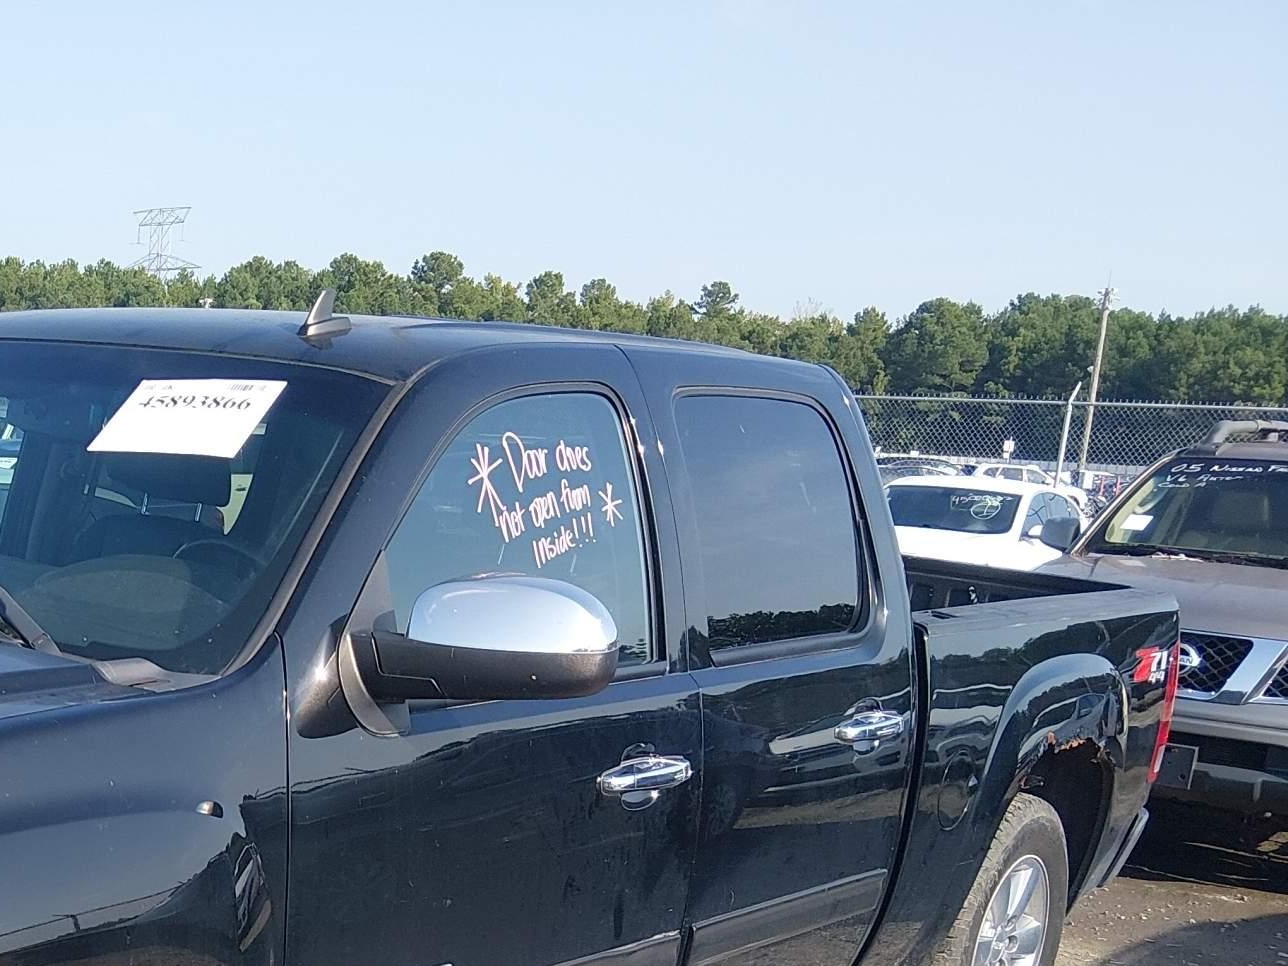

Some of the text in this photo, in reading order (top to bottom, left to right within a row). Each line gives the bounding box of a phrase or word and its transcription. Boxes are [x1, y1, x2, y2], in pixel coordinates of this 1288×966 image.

[139, 395, 251, 409] 45893866
[502, 432, 592, 492] Door does
[529, 491, 560, 528] open
[560, 479, 591, 513] from
